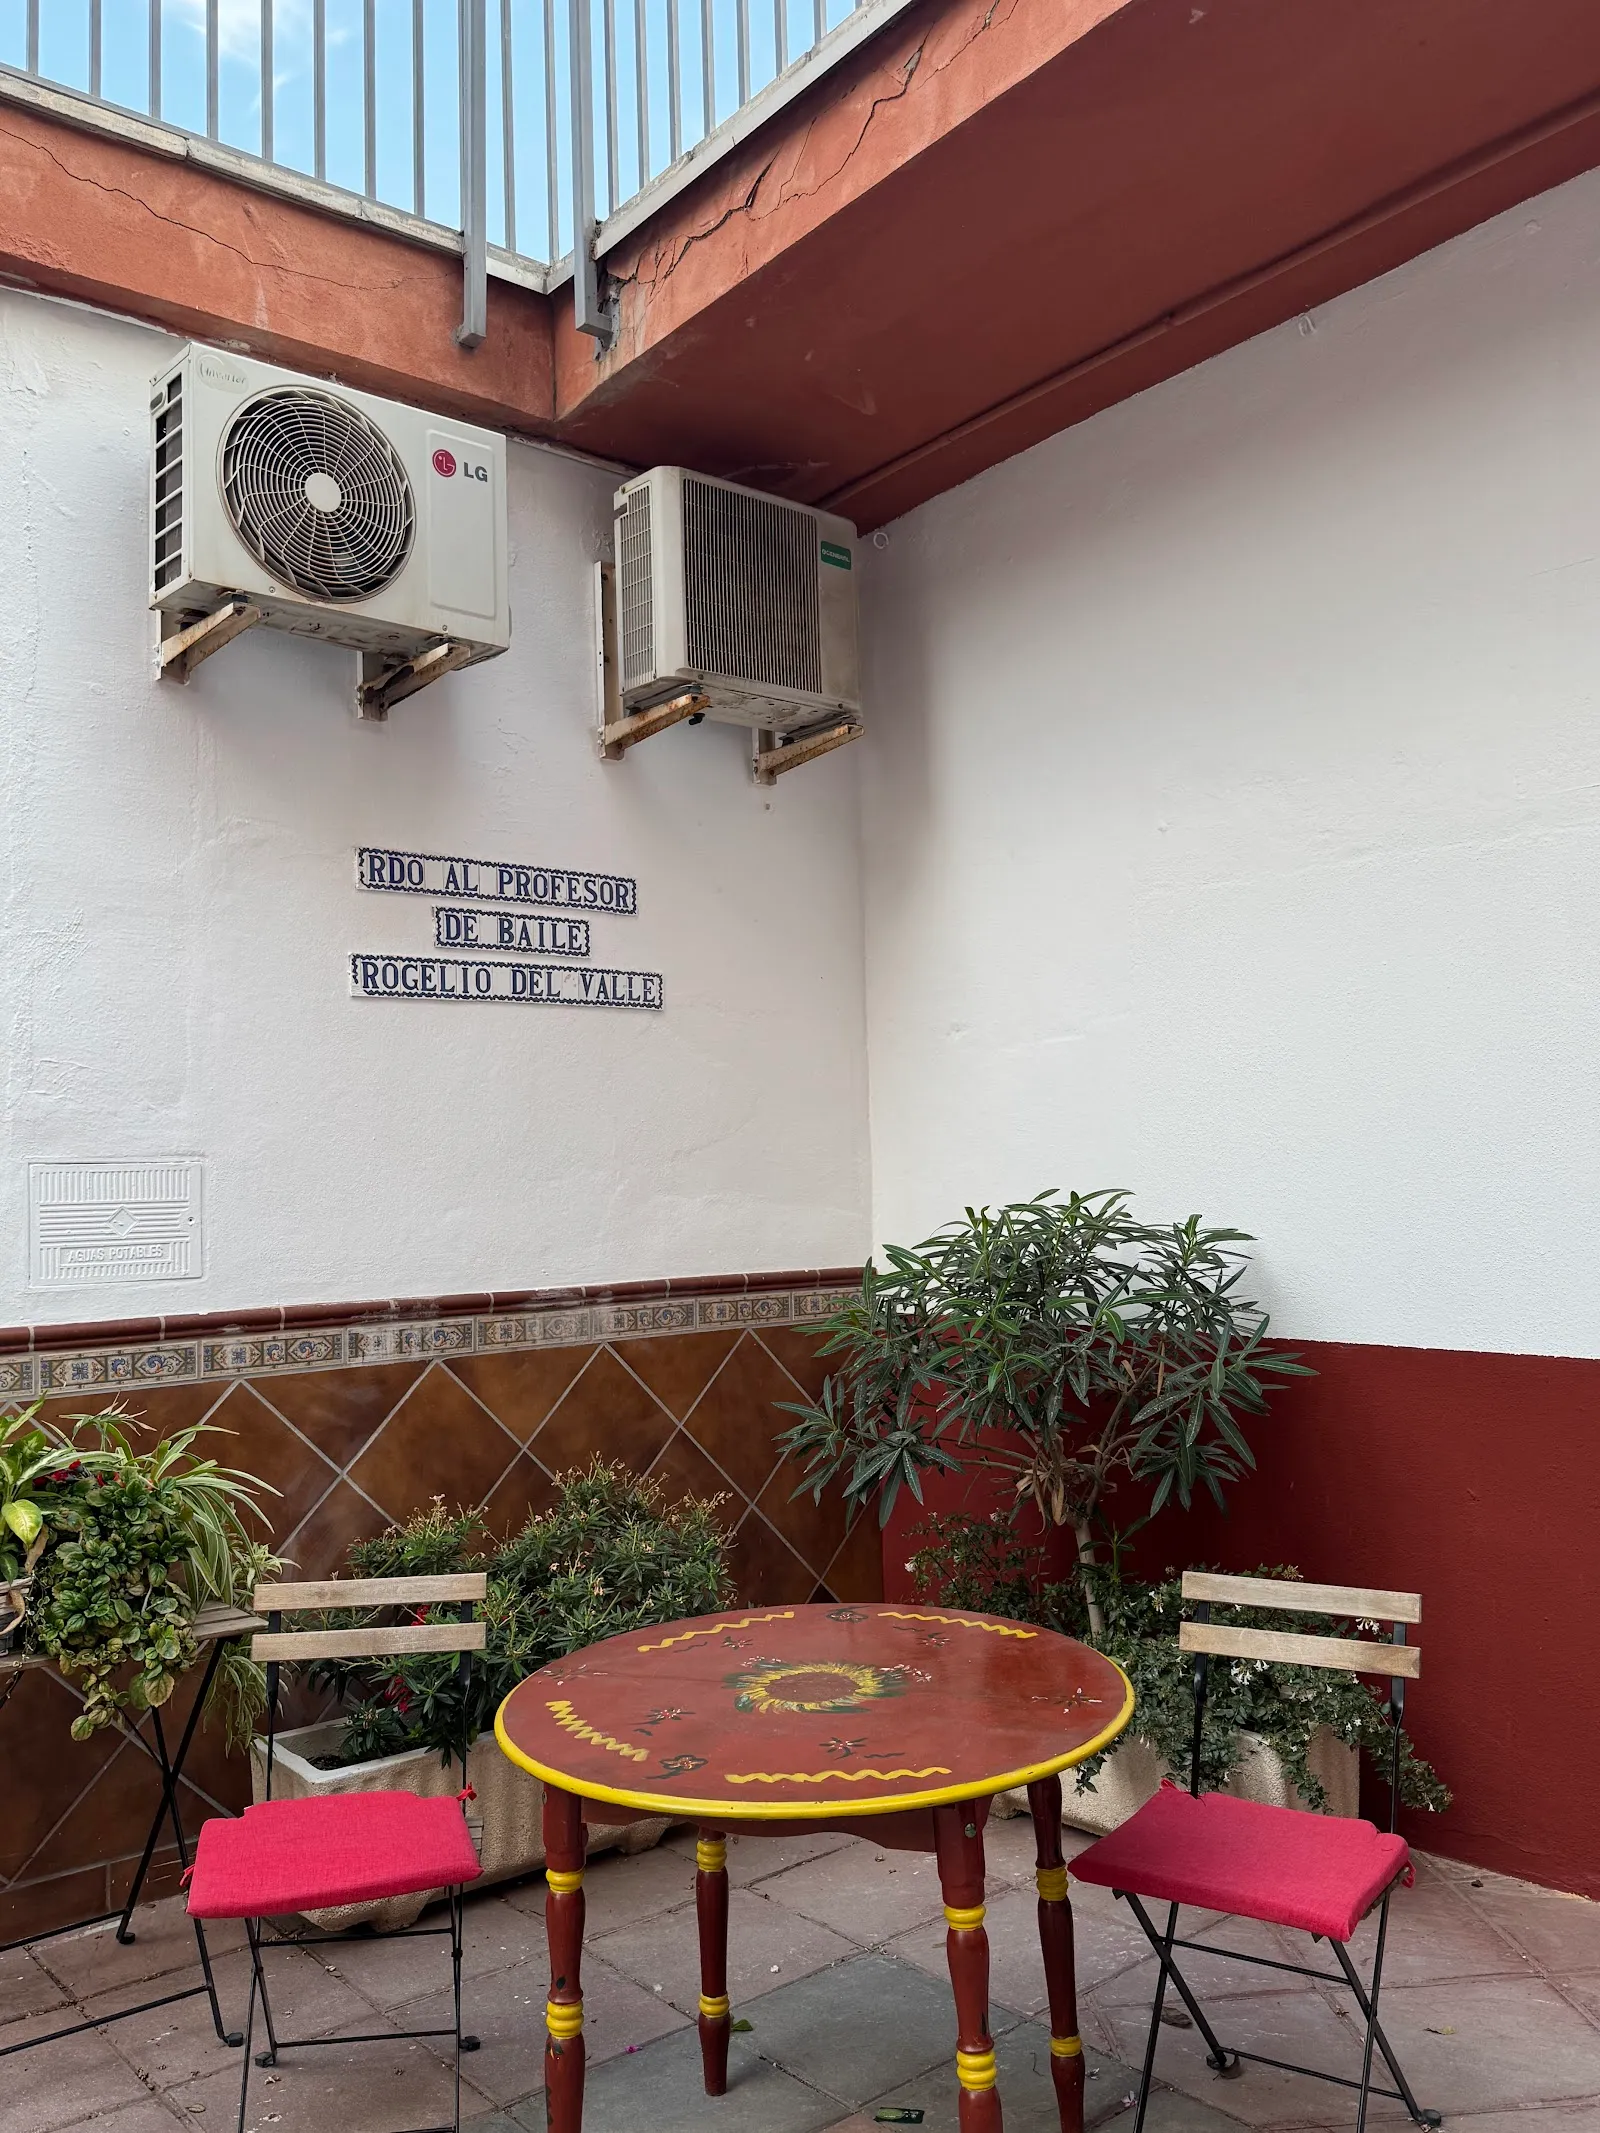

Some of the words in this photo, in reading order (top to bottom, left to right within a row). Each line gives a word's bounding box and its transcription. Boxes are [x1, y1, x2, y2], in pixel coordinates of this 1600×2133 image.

[463, 461, 488, 483] LG
[368, 853, 424, 886] RDO
[444, 864, 479, 892] AL
[498, 869, 630, 908] PROFESOR
[445, 914, 479, 943] DE
[499, 917, 582, 950] BAILE
[362, 961, 492, 994] ROGELIO
[511, 969, 561, 998] DEL
[579, 973, 656, 1003] VALLE
[68, 1249, 106, 1263] AGUAS
[109, 1245, 164, 1260] POTABLES
